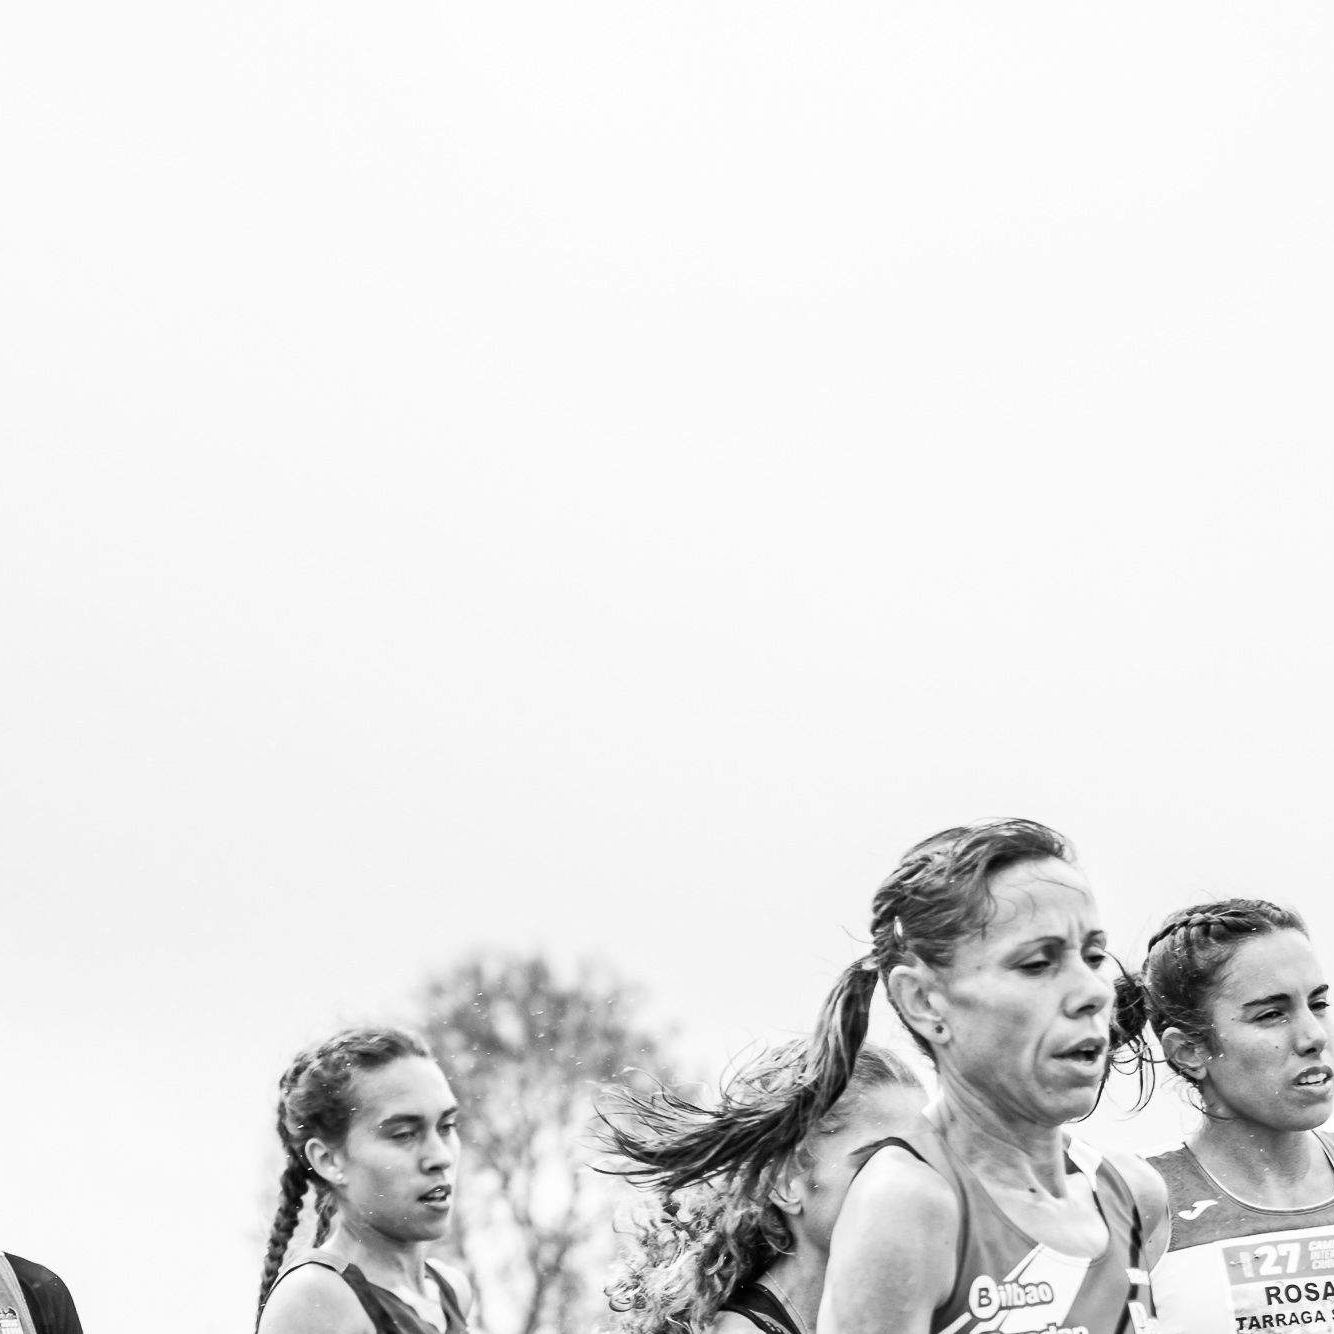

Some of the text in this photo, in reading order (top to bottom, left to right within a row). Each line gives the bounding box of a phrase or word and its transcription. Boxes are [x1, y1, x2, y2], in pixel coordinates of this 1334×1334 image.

[1254, 1242, 1301, 1276] 27
[969, 1275, 1054, 1319] Bilbao
[1236, 1310, 1326, 1331] TARRAGA
